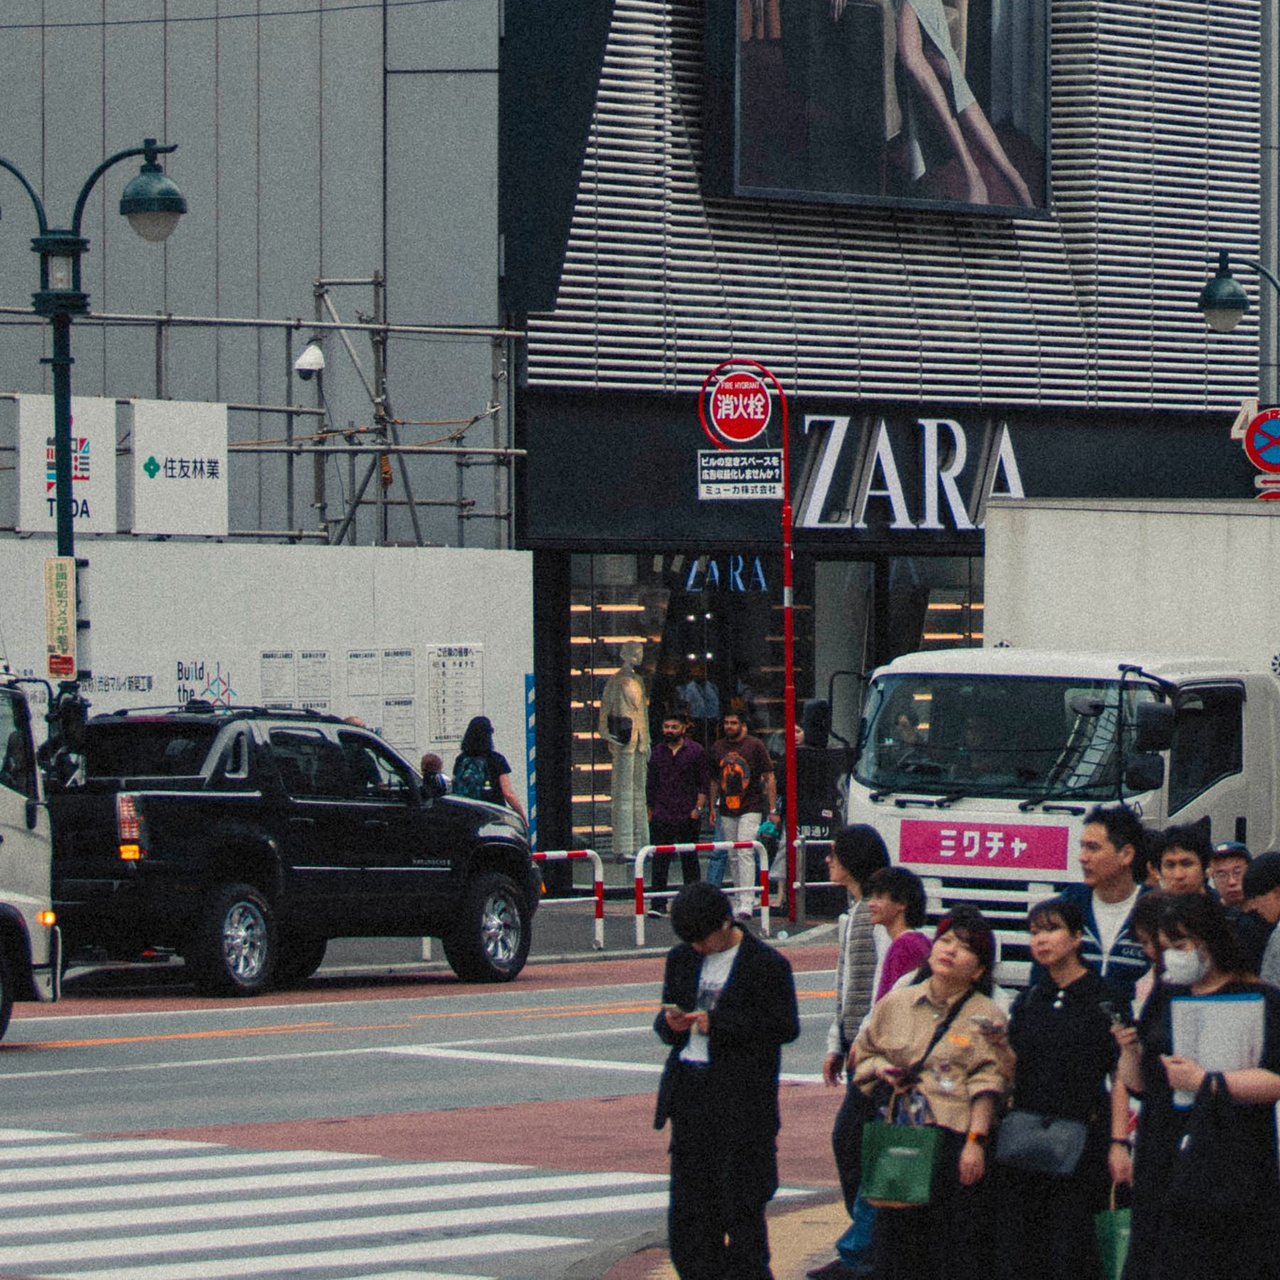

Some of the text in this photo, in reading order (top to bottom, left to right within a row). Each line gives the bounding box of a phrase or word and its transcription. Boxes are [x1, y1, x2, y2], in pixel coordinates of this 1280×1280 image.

[721, 381, 760, 389] FIRE HYDRANT
[716, 393, 766, 420] 消火栓
[163, 456, 220, 480] 住友林業
[701, 456, 780, 467] ビルの空きスペースを
[794, 414, 1025, 530] ZARA
[705, 485, 777, 495] ミューカ株式会社
[46, 498, 90, 519] TDA
[176, 661, 205, 681] Build
[177, 684, 196, 703] the
[939, 829, 1028, 859] ミクチャ
